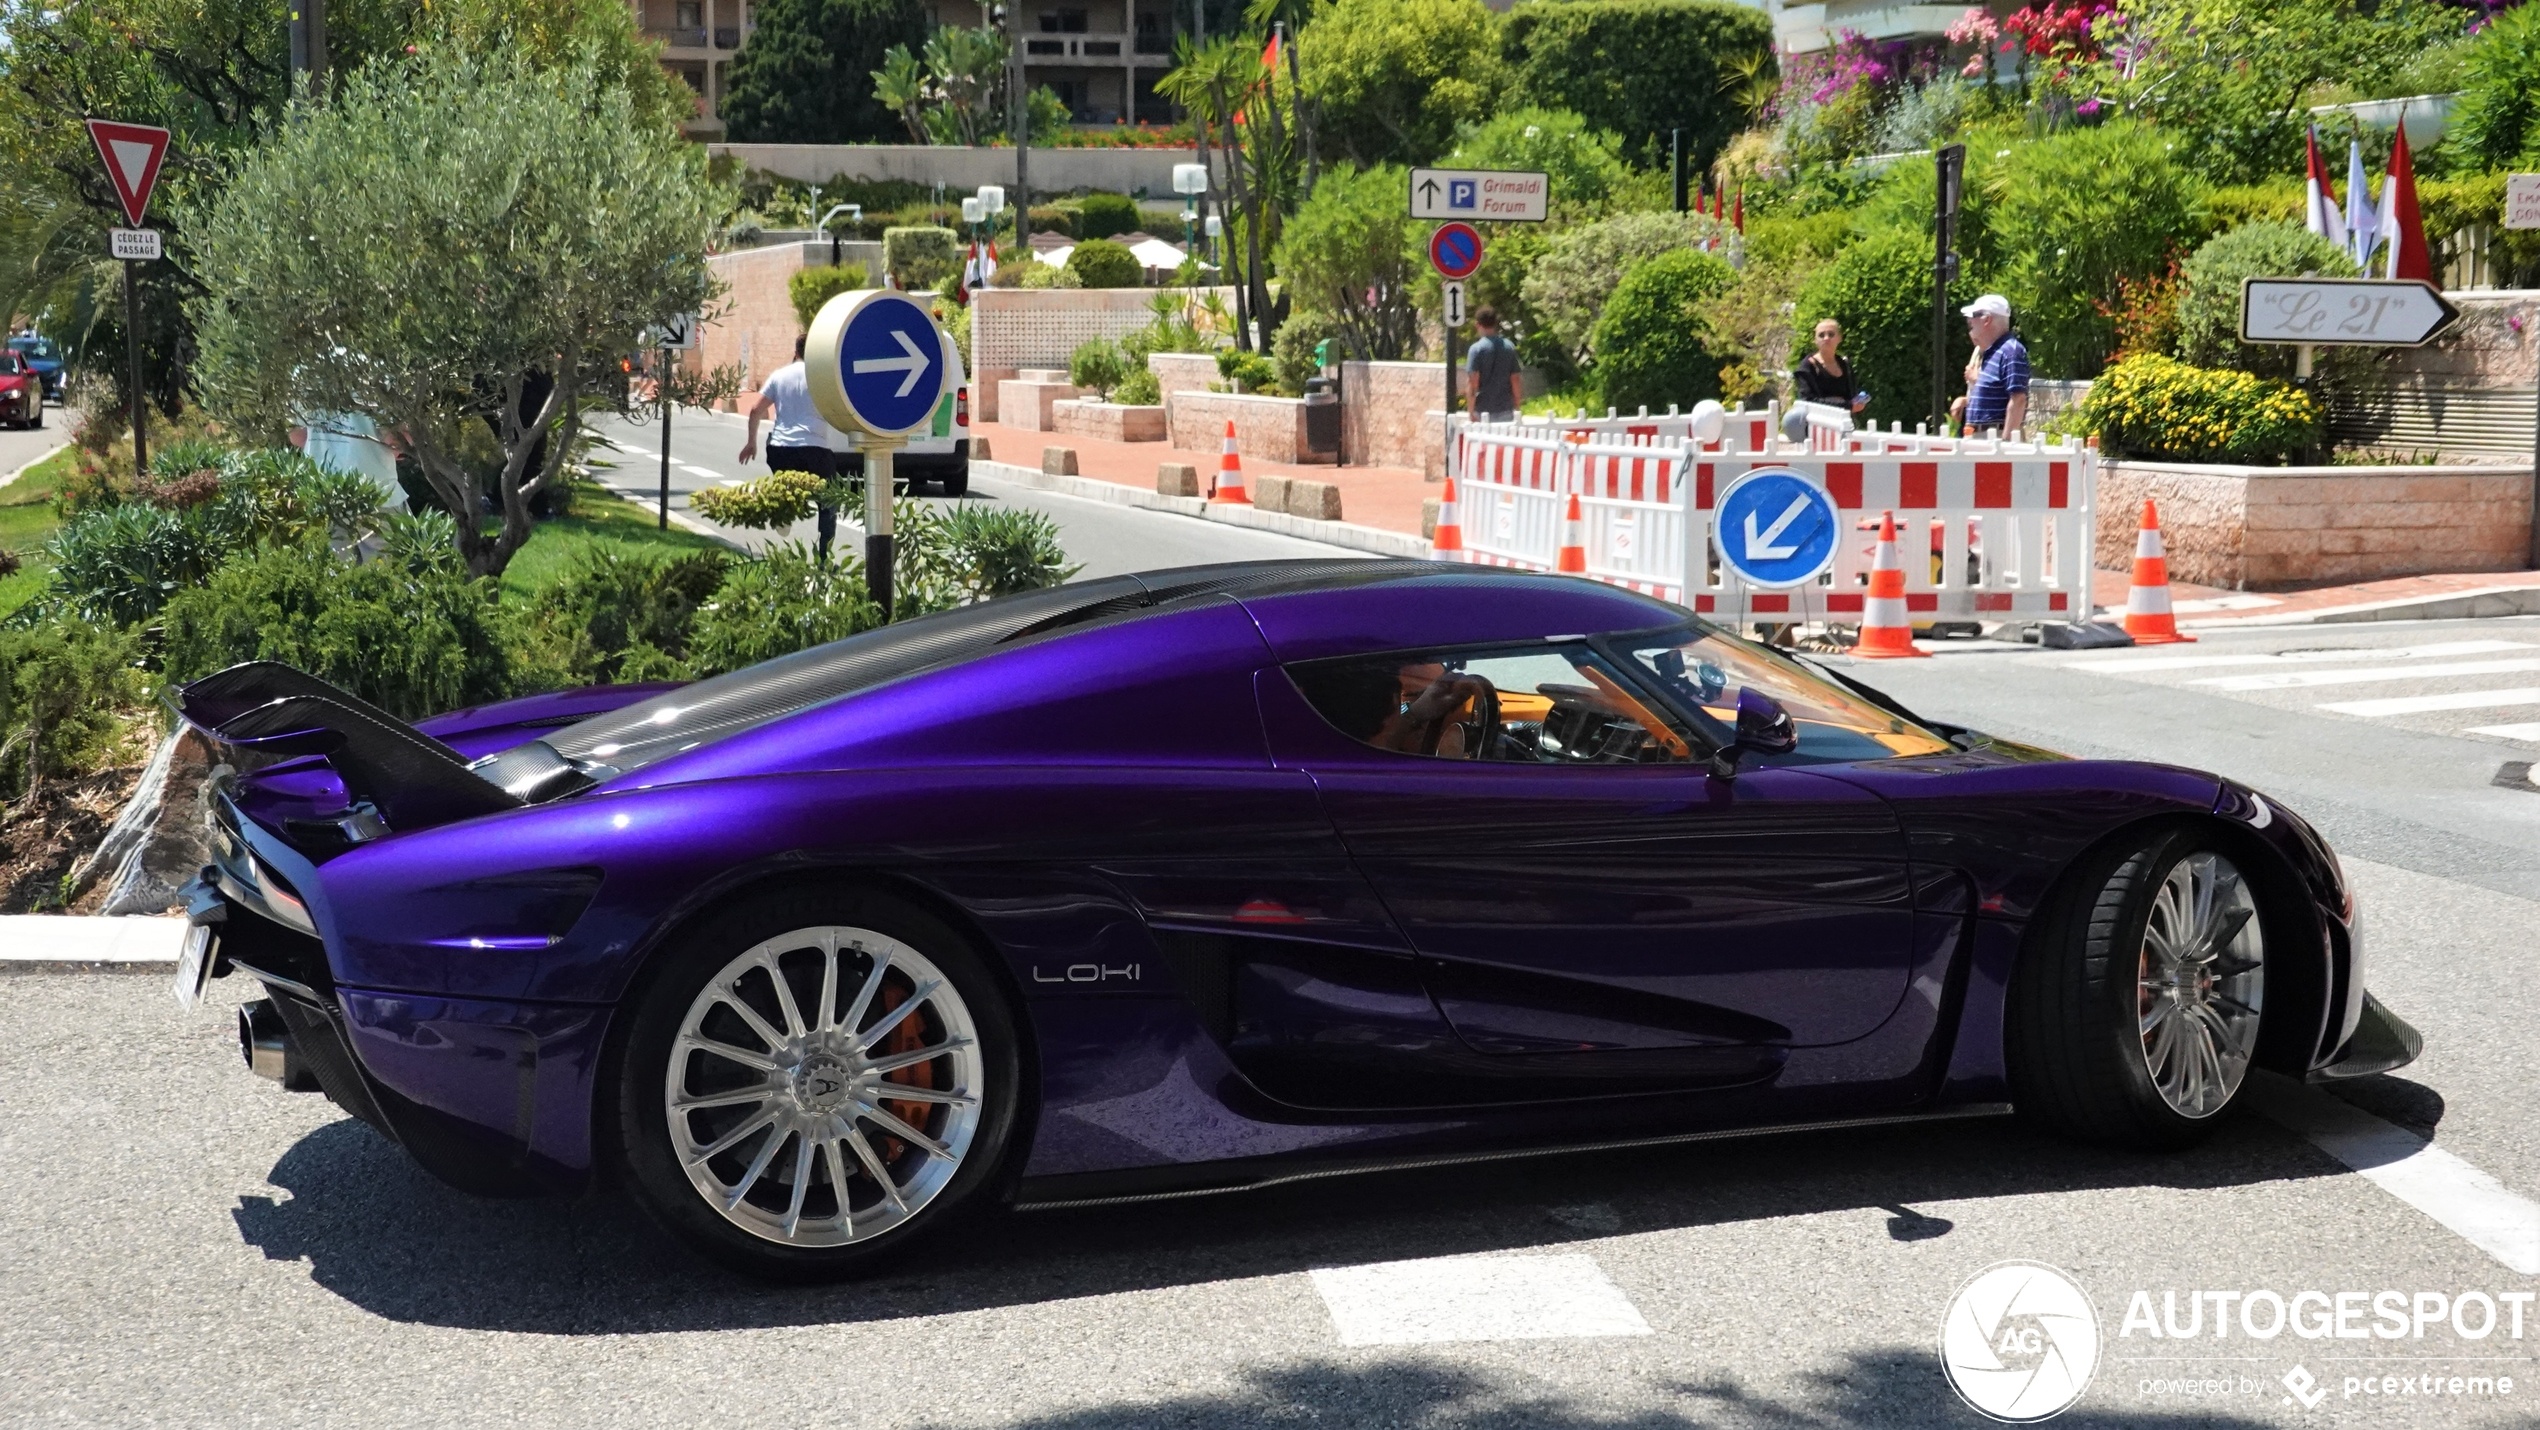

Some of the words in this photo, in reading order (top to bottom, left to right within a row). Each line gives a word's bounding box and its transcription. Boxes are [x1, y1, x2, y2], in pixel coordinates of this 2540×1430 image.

[1455, 184, 1471, 204] P
[1483, 179, 1540, 194] Grimaldi
[1483, 198, 1526, 213] Forum
[117, 231, 144, 244] CÉDEZ
[145, 234, 155, 244] LE
[118, 245, 155, 256] PASSAGE
[1033, 963, 1140, 982] LOKI
